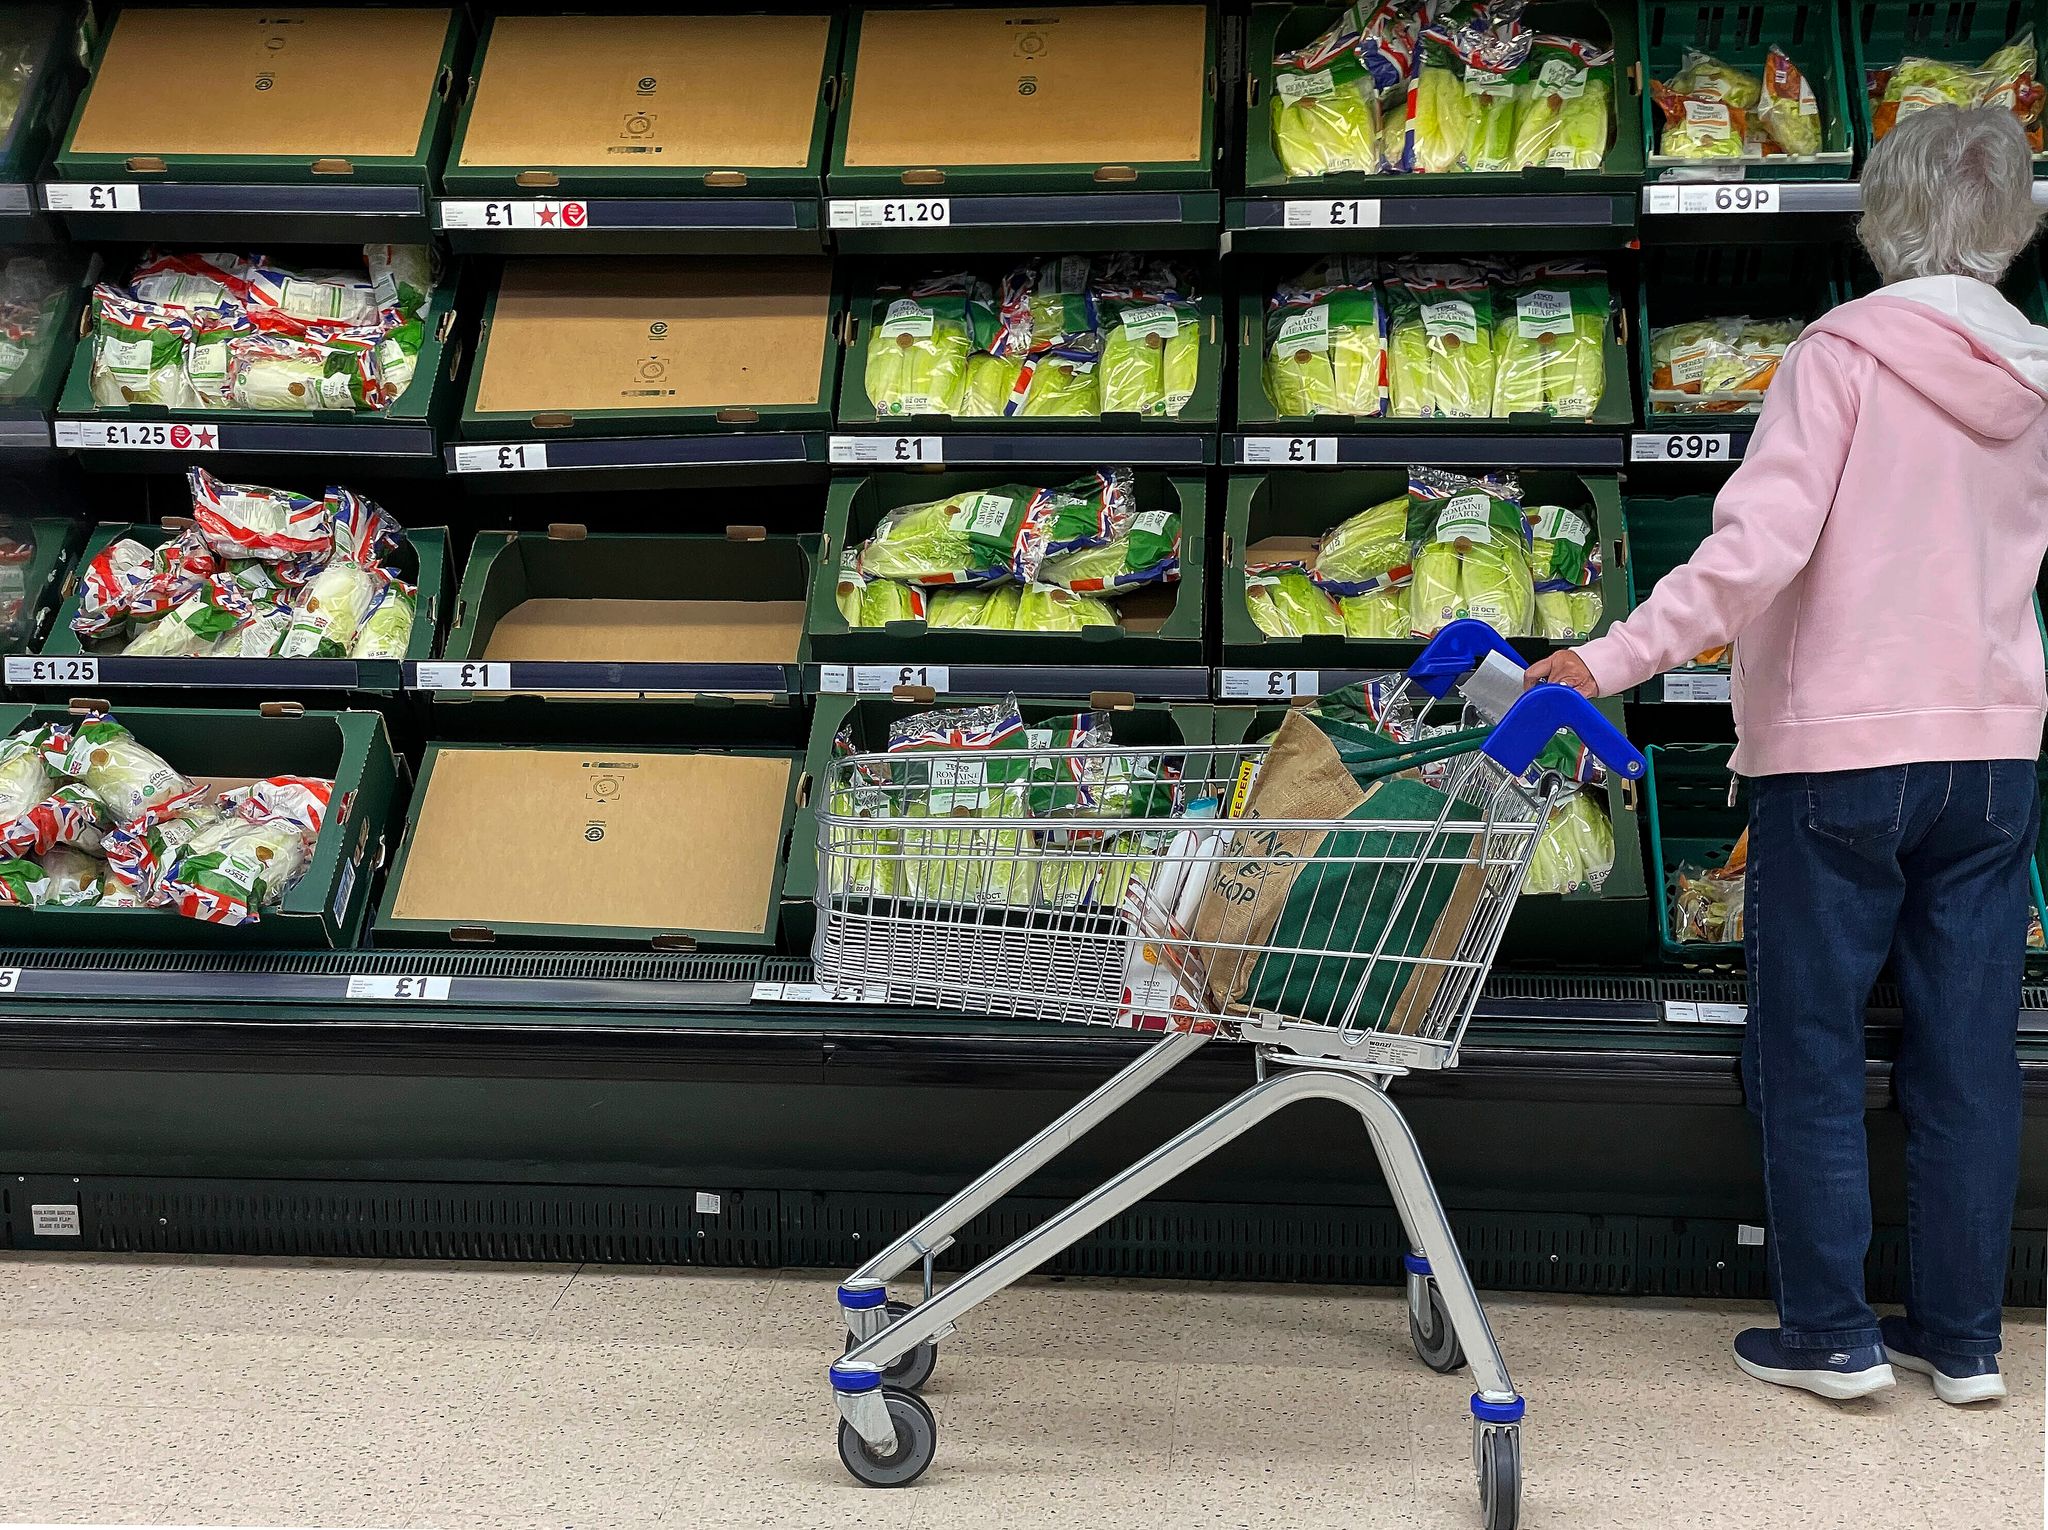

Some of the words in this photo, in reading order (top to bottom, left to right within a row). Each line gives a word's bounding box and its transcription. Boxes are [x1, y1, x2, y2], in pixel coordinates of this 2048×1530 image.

[90, 186, 117, 208] £1
[1715, 187, 1769, 209] 69p
[485, 203, 513, 226] £1
[883, 203, 944, 221] £1.20
[1330, 202, 1358, 225] £1
[1527, 307, 1562, 316] HEARTS
[106, 426, 166, 444] £1.25
[895, 438, 922, 460] £1
[1288, 439, 1316, 461] £1
[1666, 436, 1720, 458] 69p
[498, 446, 525, 468] £1
[1442, 503, 1484, 517] ROMAINE
[1451, 497, 1473, 507] TESCO
[1445, 511, 1480, 522] HEARTS
[33, 661, 94, 680] £1.25
[461, 664, 488, 687] £1
[899, 667, 927, 685] £1
[1268, 671, 1297, 695] £1
[936, 771, 978, 780] ROMAINE
[225, 869, 247, 883] TESCO
[1599, 870, 1611, 878] OC
[394, 977, 428, 997] £1
